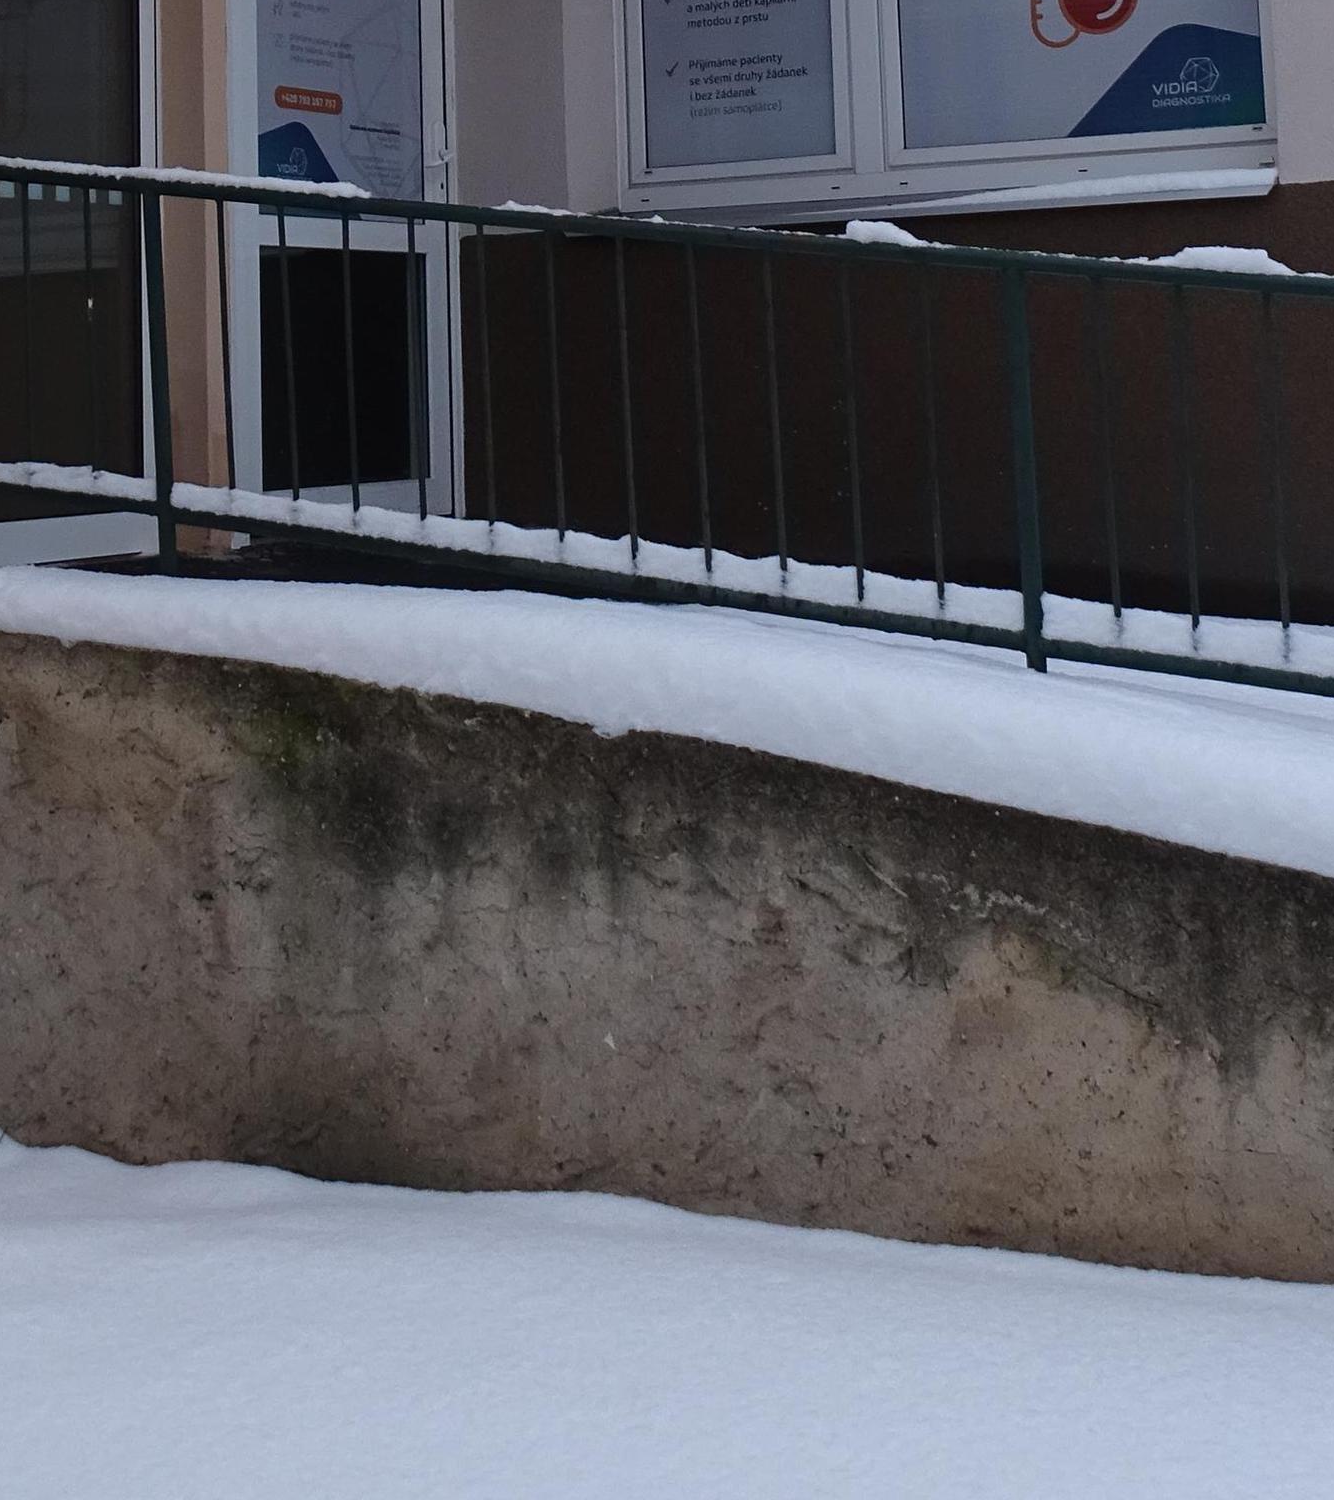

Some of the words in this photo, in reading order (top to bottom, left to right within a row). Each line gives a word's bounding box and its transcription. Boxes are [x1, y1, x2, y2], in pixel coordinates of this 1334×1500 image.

[695, 0, 730, 13] malých
[687, 16, 731, 28] metodou
[742, 12, 769, 25] prstu
[689, 57, 737, 71] Přijímáme
[740, 53, 782, 68] pacienty
[689, 77, 700, 86] se
[703, 72, 732, 84] všemi
[734, 71, 763, 82] druhy
[767, 66, 808, 79] žádanek
[695, 91, 712, 101] bez
[715, 86, 757, 100] žádanek
[1152, 81, 1198, 95] VIDIA
[1152, 94, 1231, 108] DIAGNOSTIKA
